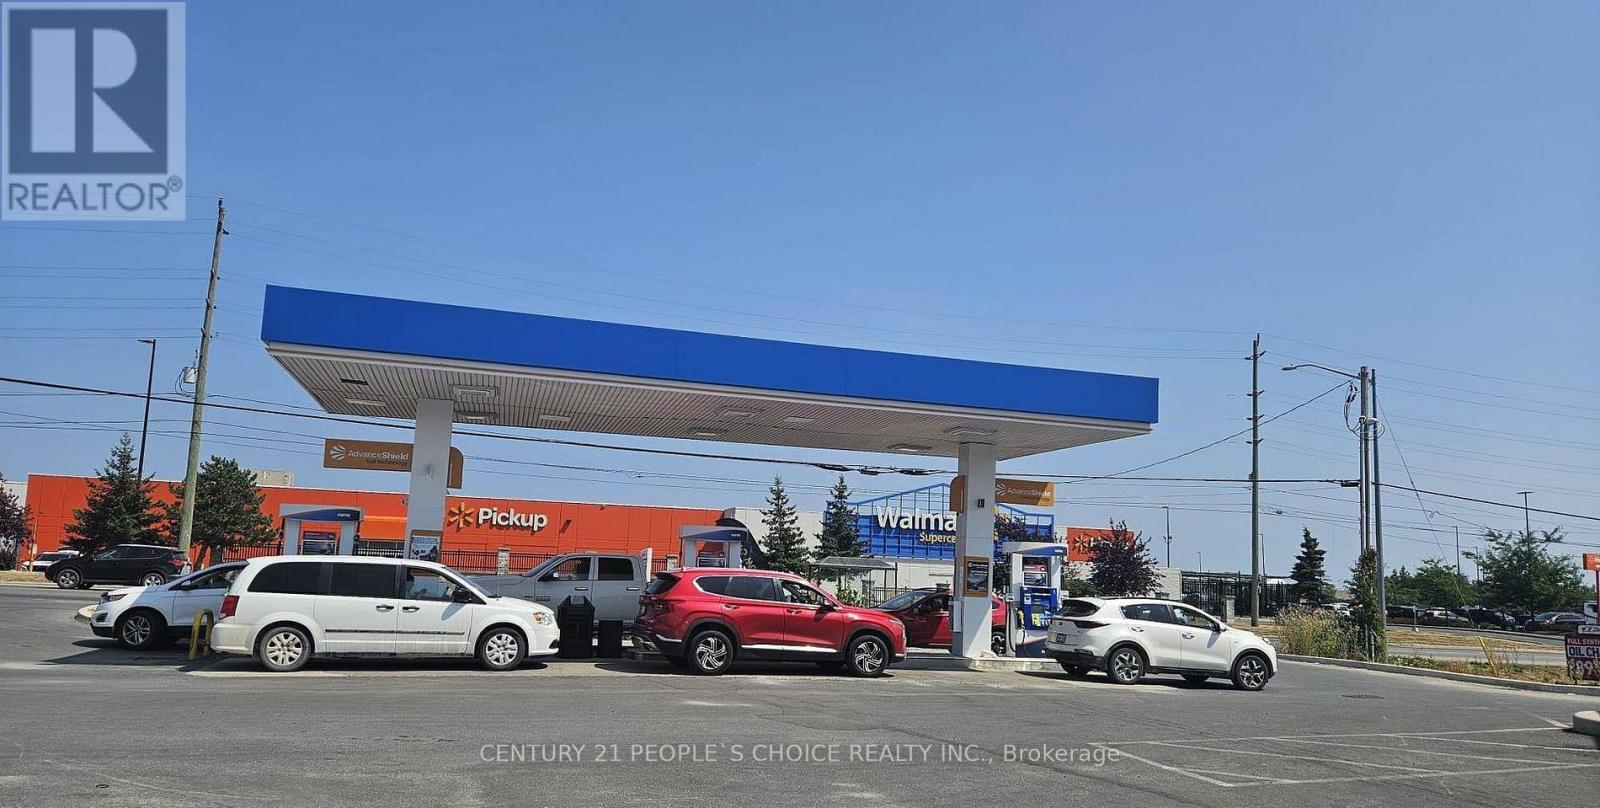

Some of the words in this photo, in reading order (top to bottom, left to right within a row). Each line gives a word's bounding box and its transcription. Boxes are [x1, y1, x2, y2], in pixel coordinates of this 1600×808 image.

[347, 449, 409, 460] AdvanceShield
[478, 507, 548, 531] Pickup
[875, 505, 957, 531] Walma
[919, 532, 957, 544] Superce
[1567, 637, 1582, 645] FULL
[1568, 646, 1585, 657] OIL
